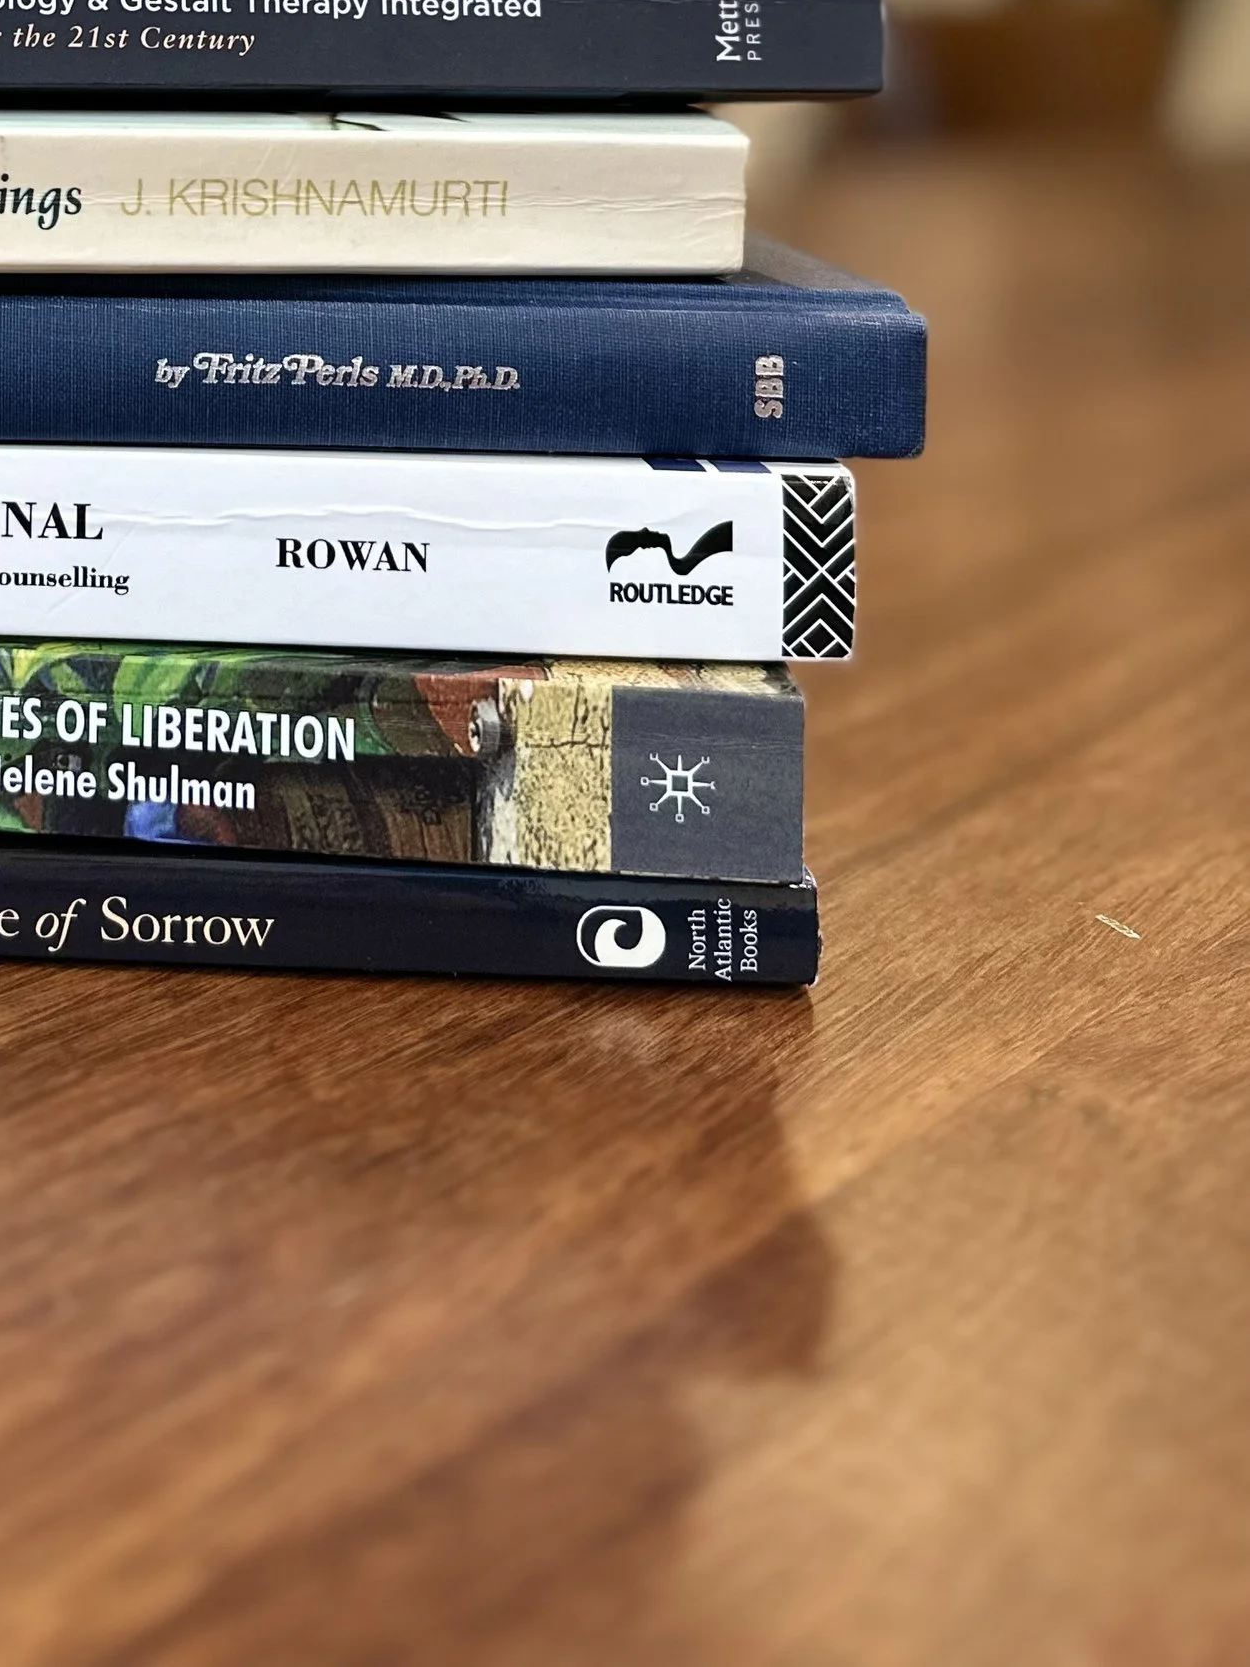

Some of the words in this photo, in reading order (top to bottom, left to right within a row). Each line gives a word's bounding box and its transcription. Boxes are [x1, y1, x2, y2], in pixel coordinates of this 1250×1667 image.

[12, 24, 55, 50] the
[67, 26, 130, 51] 21st
[140, 26, 255, 56] Century
[120, 180, 153, 218] J.
[169, 178, 508, 218] KRISHNAMURTI
[155, 359, 189, 389] by
[193, 353, 283, 385] Fritz
[282, 356, 379, 388] Perls
[754, 355, 784, 419] SBB
[275, 538, 429, 574] ROWAN
[610, 582, 733, 606] ROUTLEDGE
[56, 700, 107, 746] OF
[121, 705, 355, 762] LIBERATION
[108, 763, 255, 809] Shulman
[35, 899, 86, 951] of
[101, 896, 274, 946] Sorrow
[688, 909, 705, 971] North
[714, 898, 732, 982] Atlantic
[740, 909, 757, 972] Books
